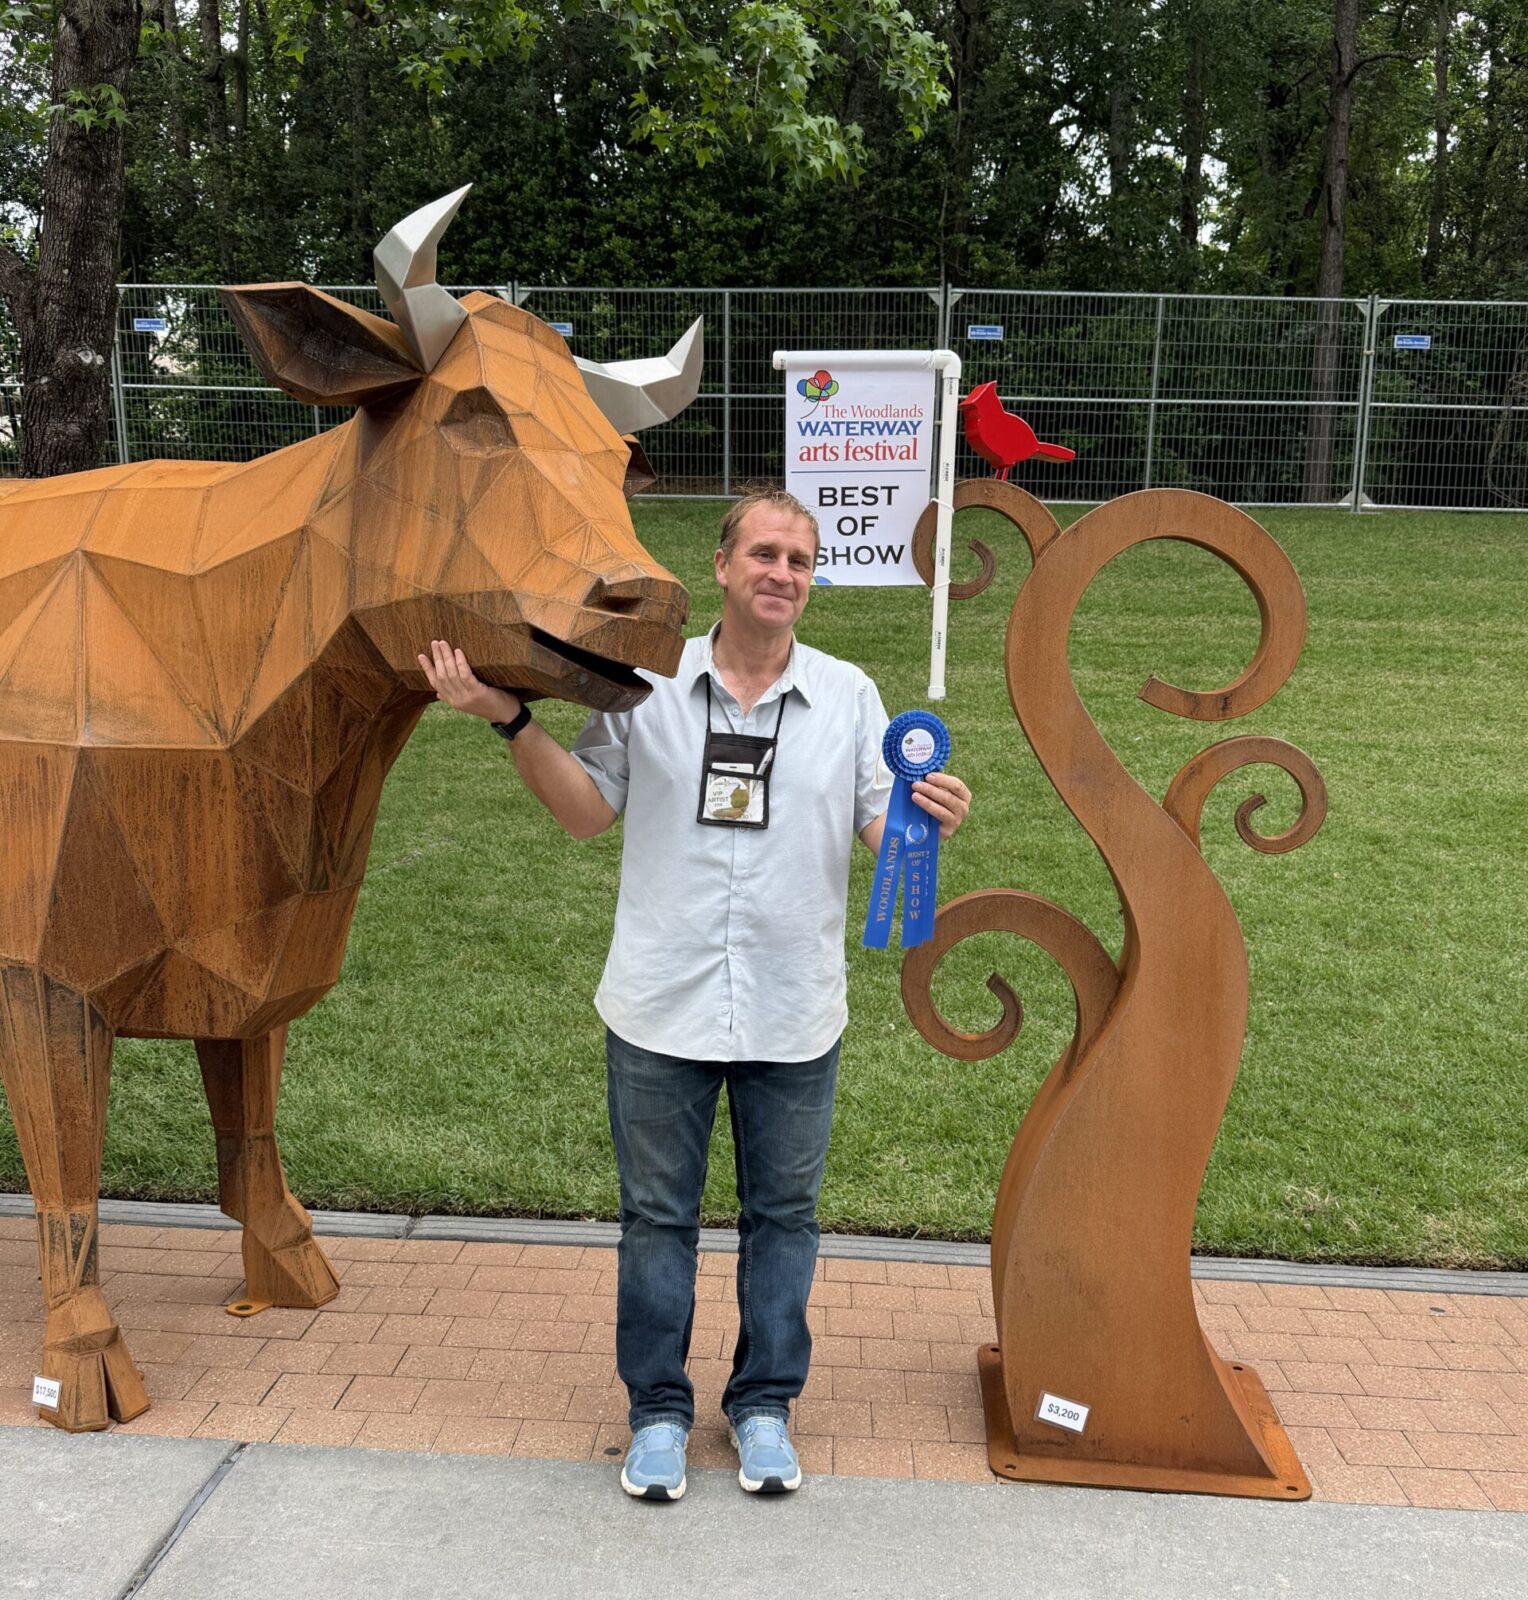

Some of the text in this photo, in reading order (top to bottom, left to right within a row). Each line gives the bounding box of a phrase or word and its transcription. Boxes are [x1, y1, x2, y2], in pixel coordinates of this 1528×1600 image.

[822, 403, 924, 418] The Woodlands
[797, 420, 923, 437] WATERWAY
[799, 437, 919, 462] arts festival
[818, 485, 900, 507] BEST
[836, 515, 879, 537] OF
[816, 544, 905, 566] SHOW
[907, 850, 926, 858] BEST
[876, 836, 900, 922] WOODLANDS
[909, 872, 921, 920] SHOW
[1047, 1403, 1080, 1421] $3,200
